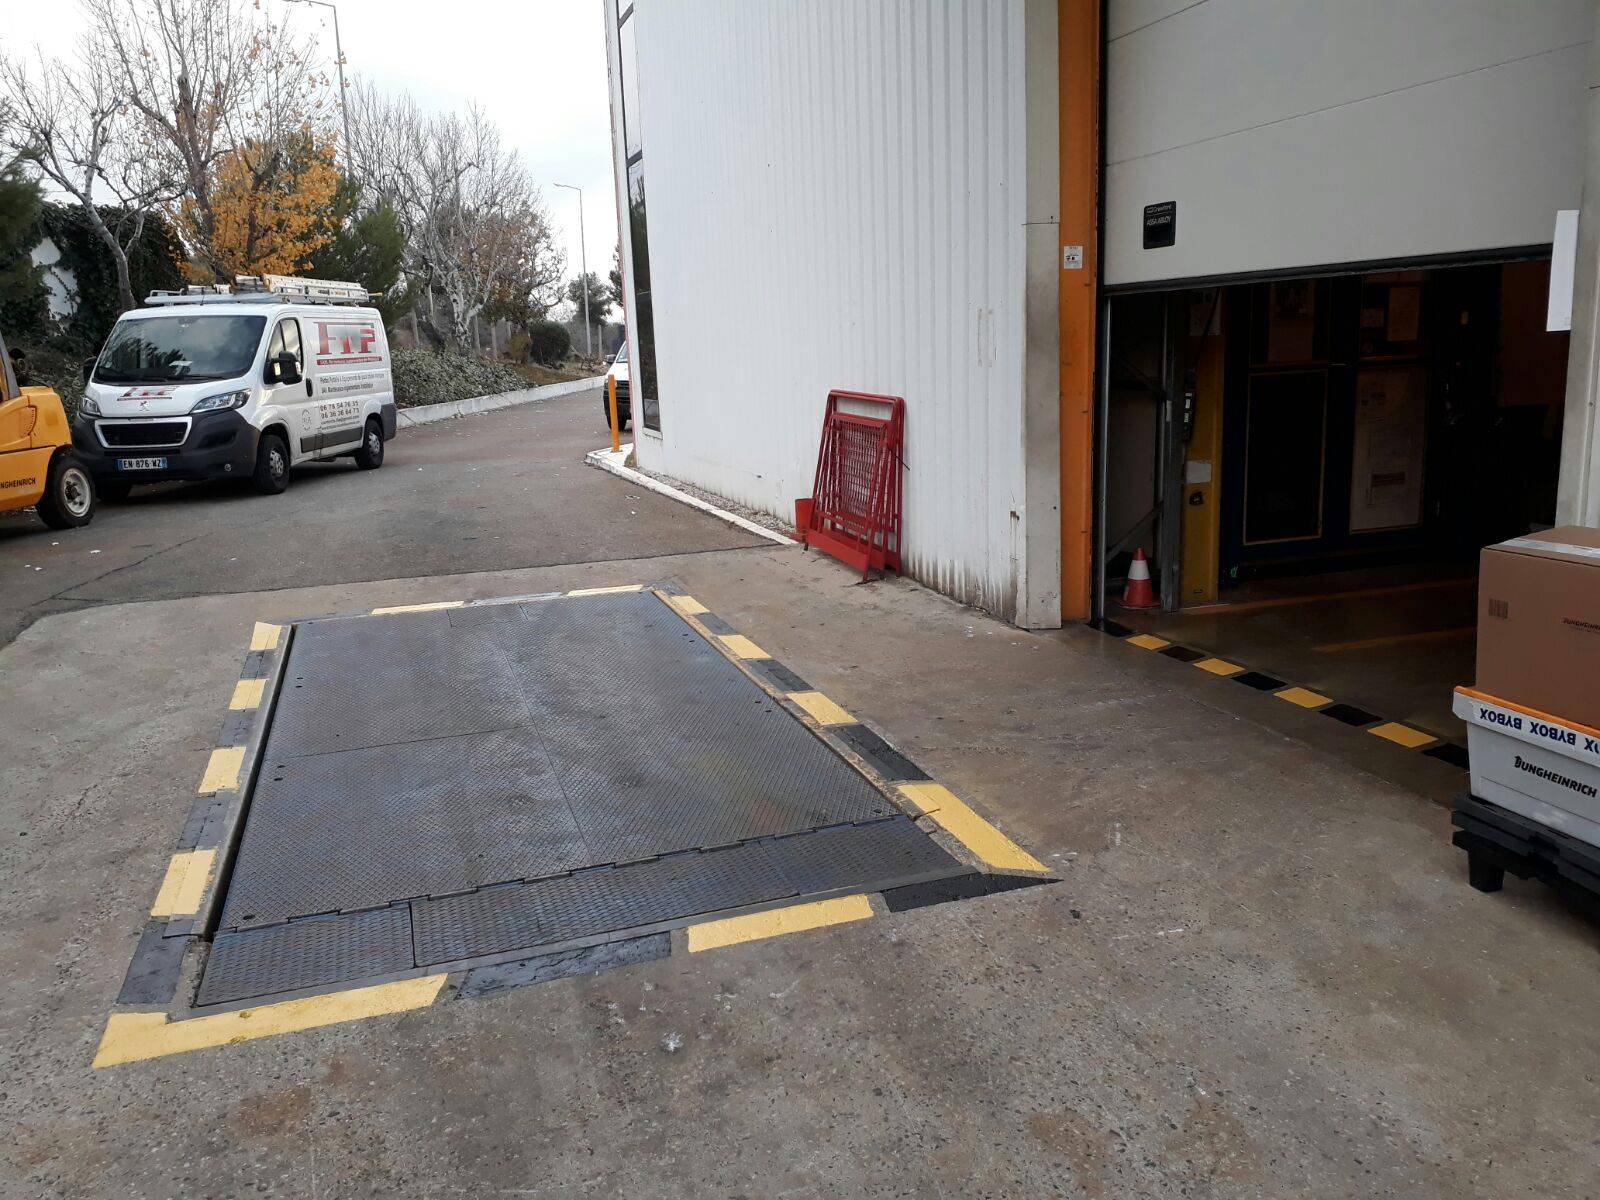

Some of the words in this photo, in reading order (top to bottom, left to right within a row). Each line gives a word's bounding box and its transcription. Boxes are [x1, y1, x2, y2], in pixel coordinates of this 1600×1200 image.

[1480, 708, 1522, 730] BYBOX
[1530, 721, 1576, 746] BYBOX
[1514, 755, 1597, 798] JUNGHEINRICH
